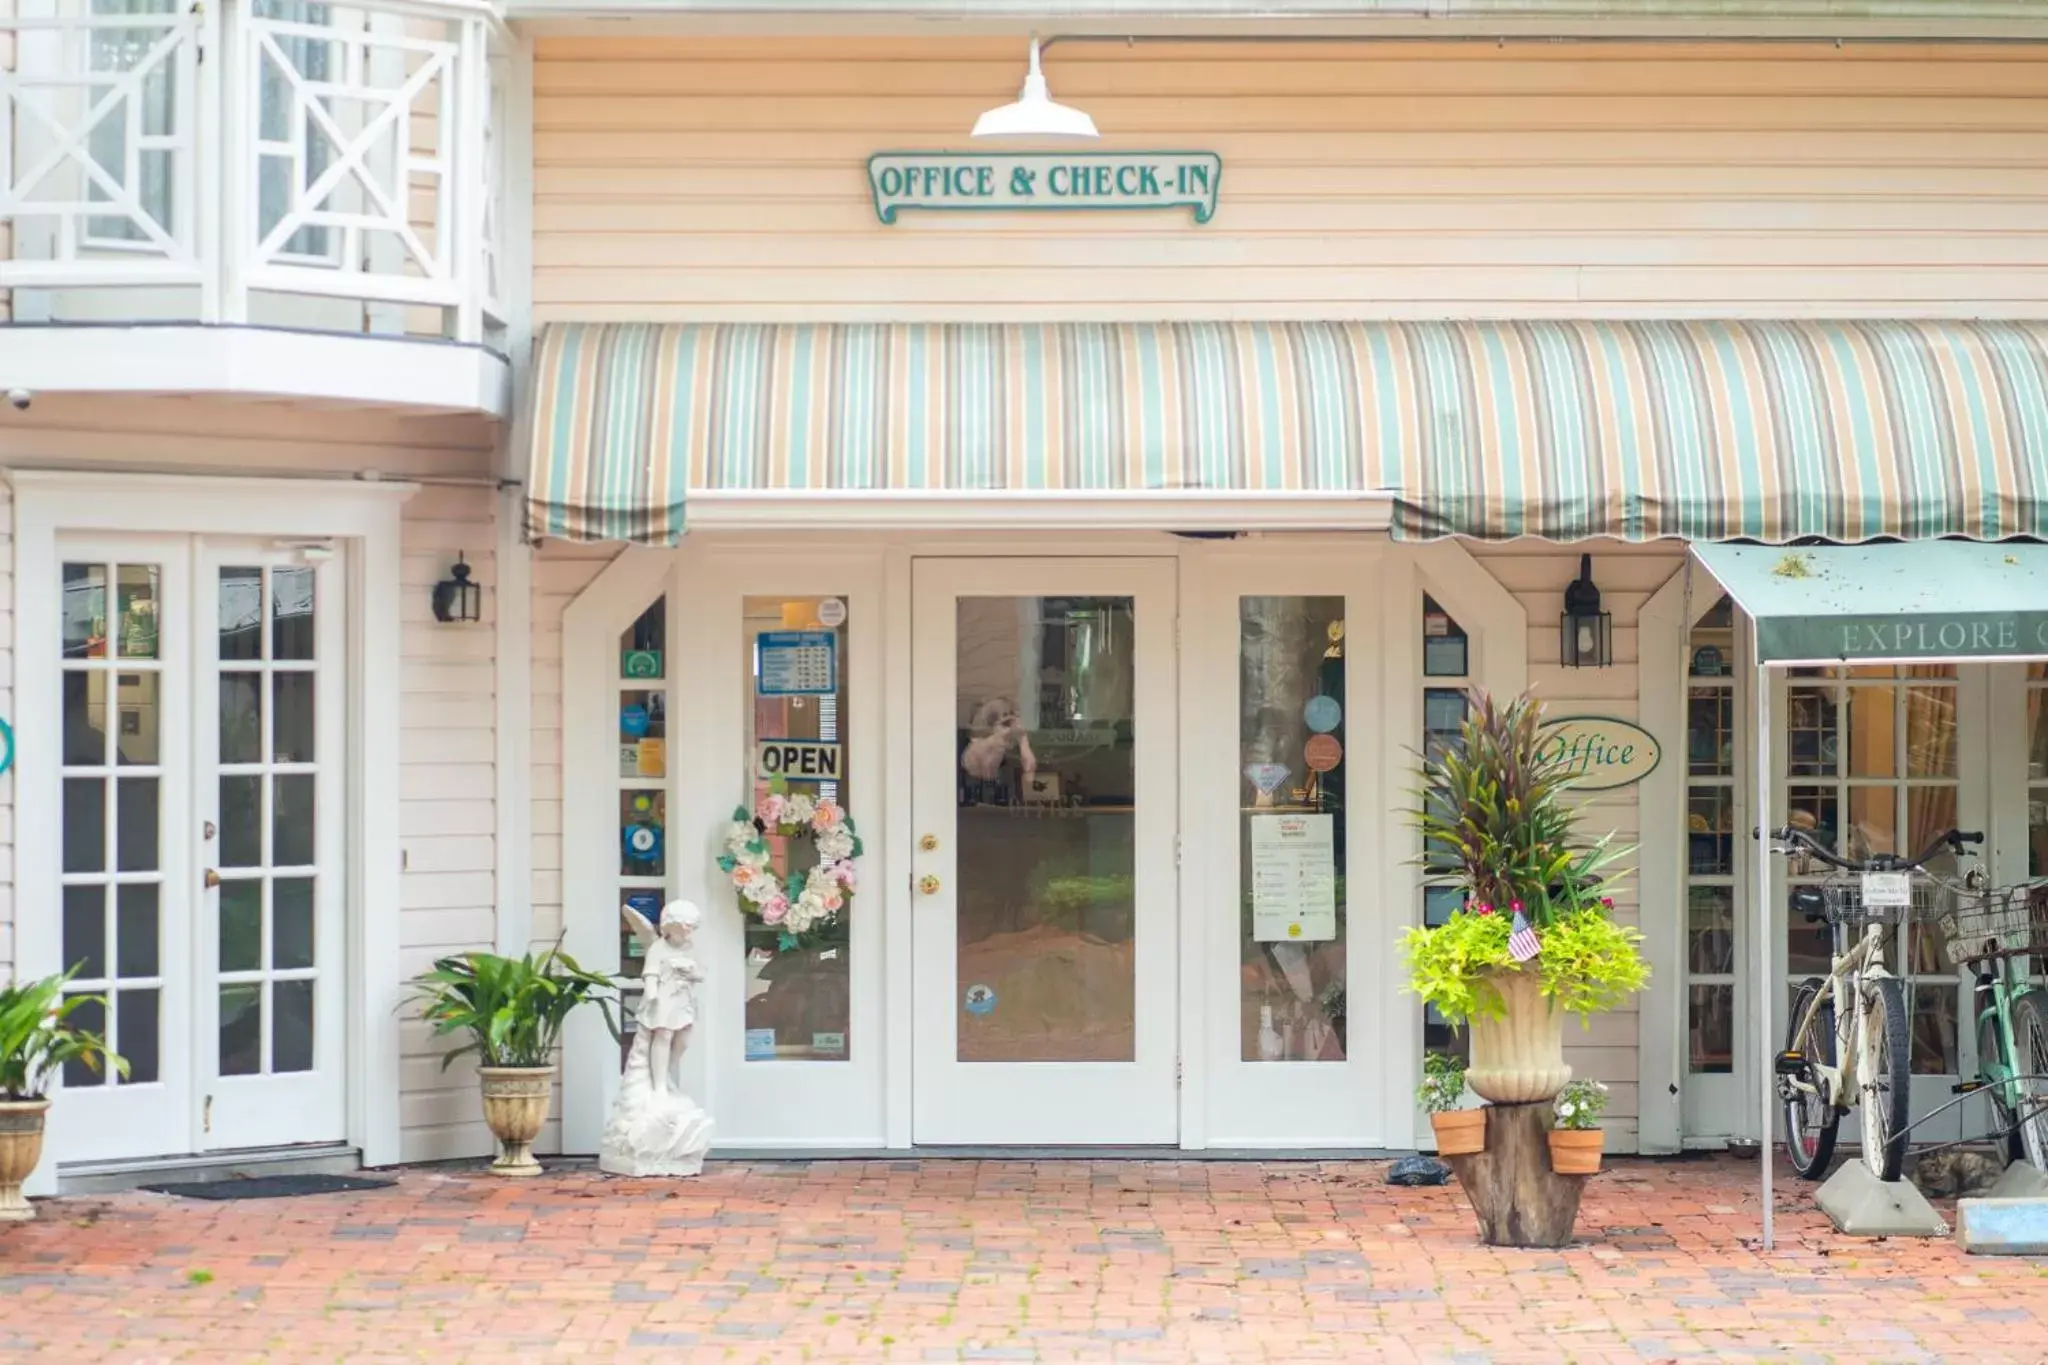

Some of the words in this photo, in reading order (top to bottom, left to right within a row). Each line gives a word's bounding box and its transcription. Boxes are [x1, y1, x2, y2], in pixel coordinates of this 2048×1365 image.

[880, 165, 995, 197] OFFICE
[1009, 165, 1037, 196] &
[1047, 164, 1210, 197] CHECK-IN
[1842, 620, 2018, 652] EXPLORE
[762, 745, 837, 775] OPEN
